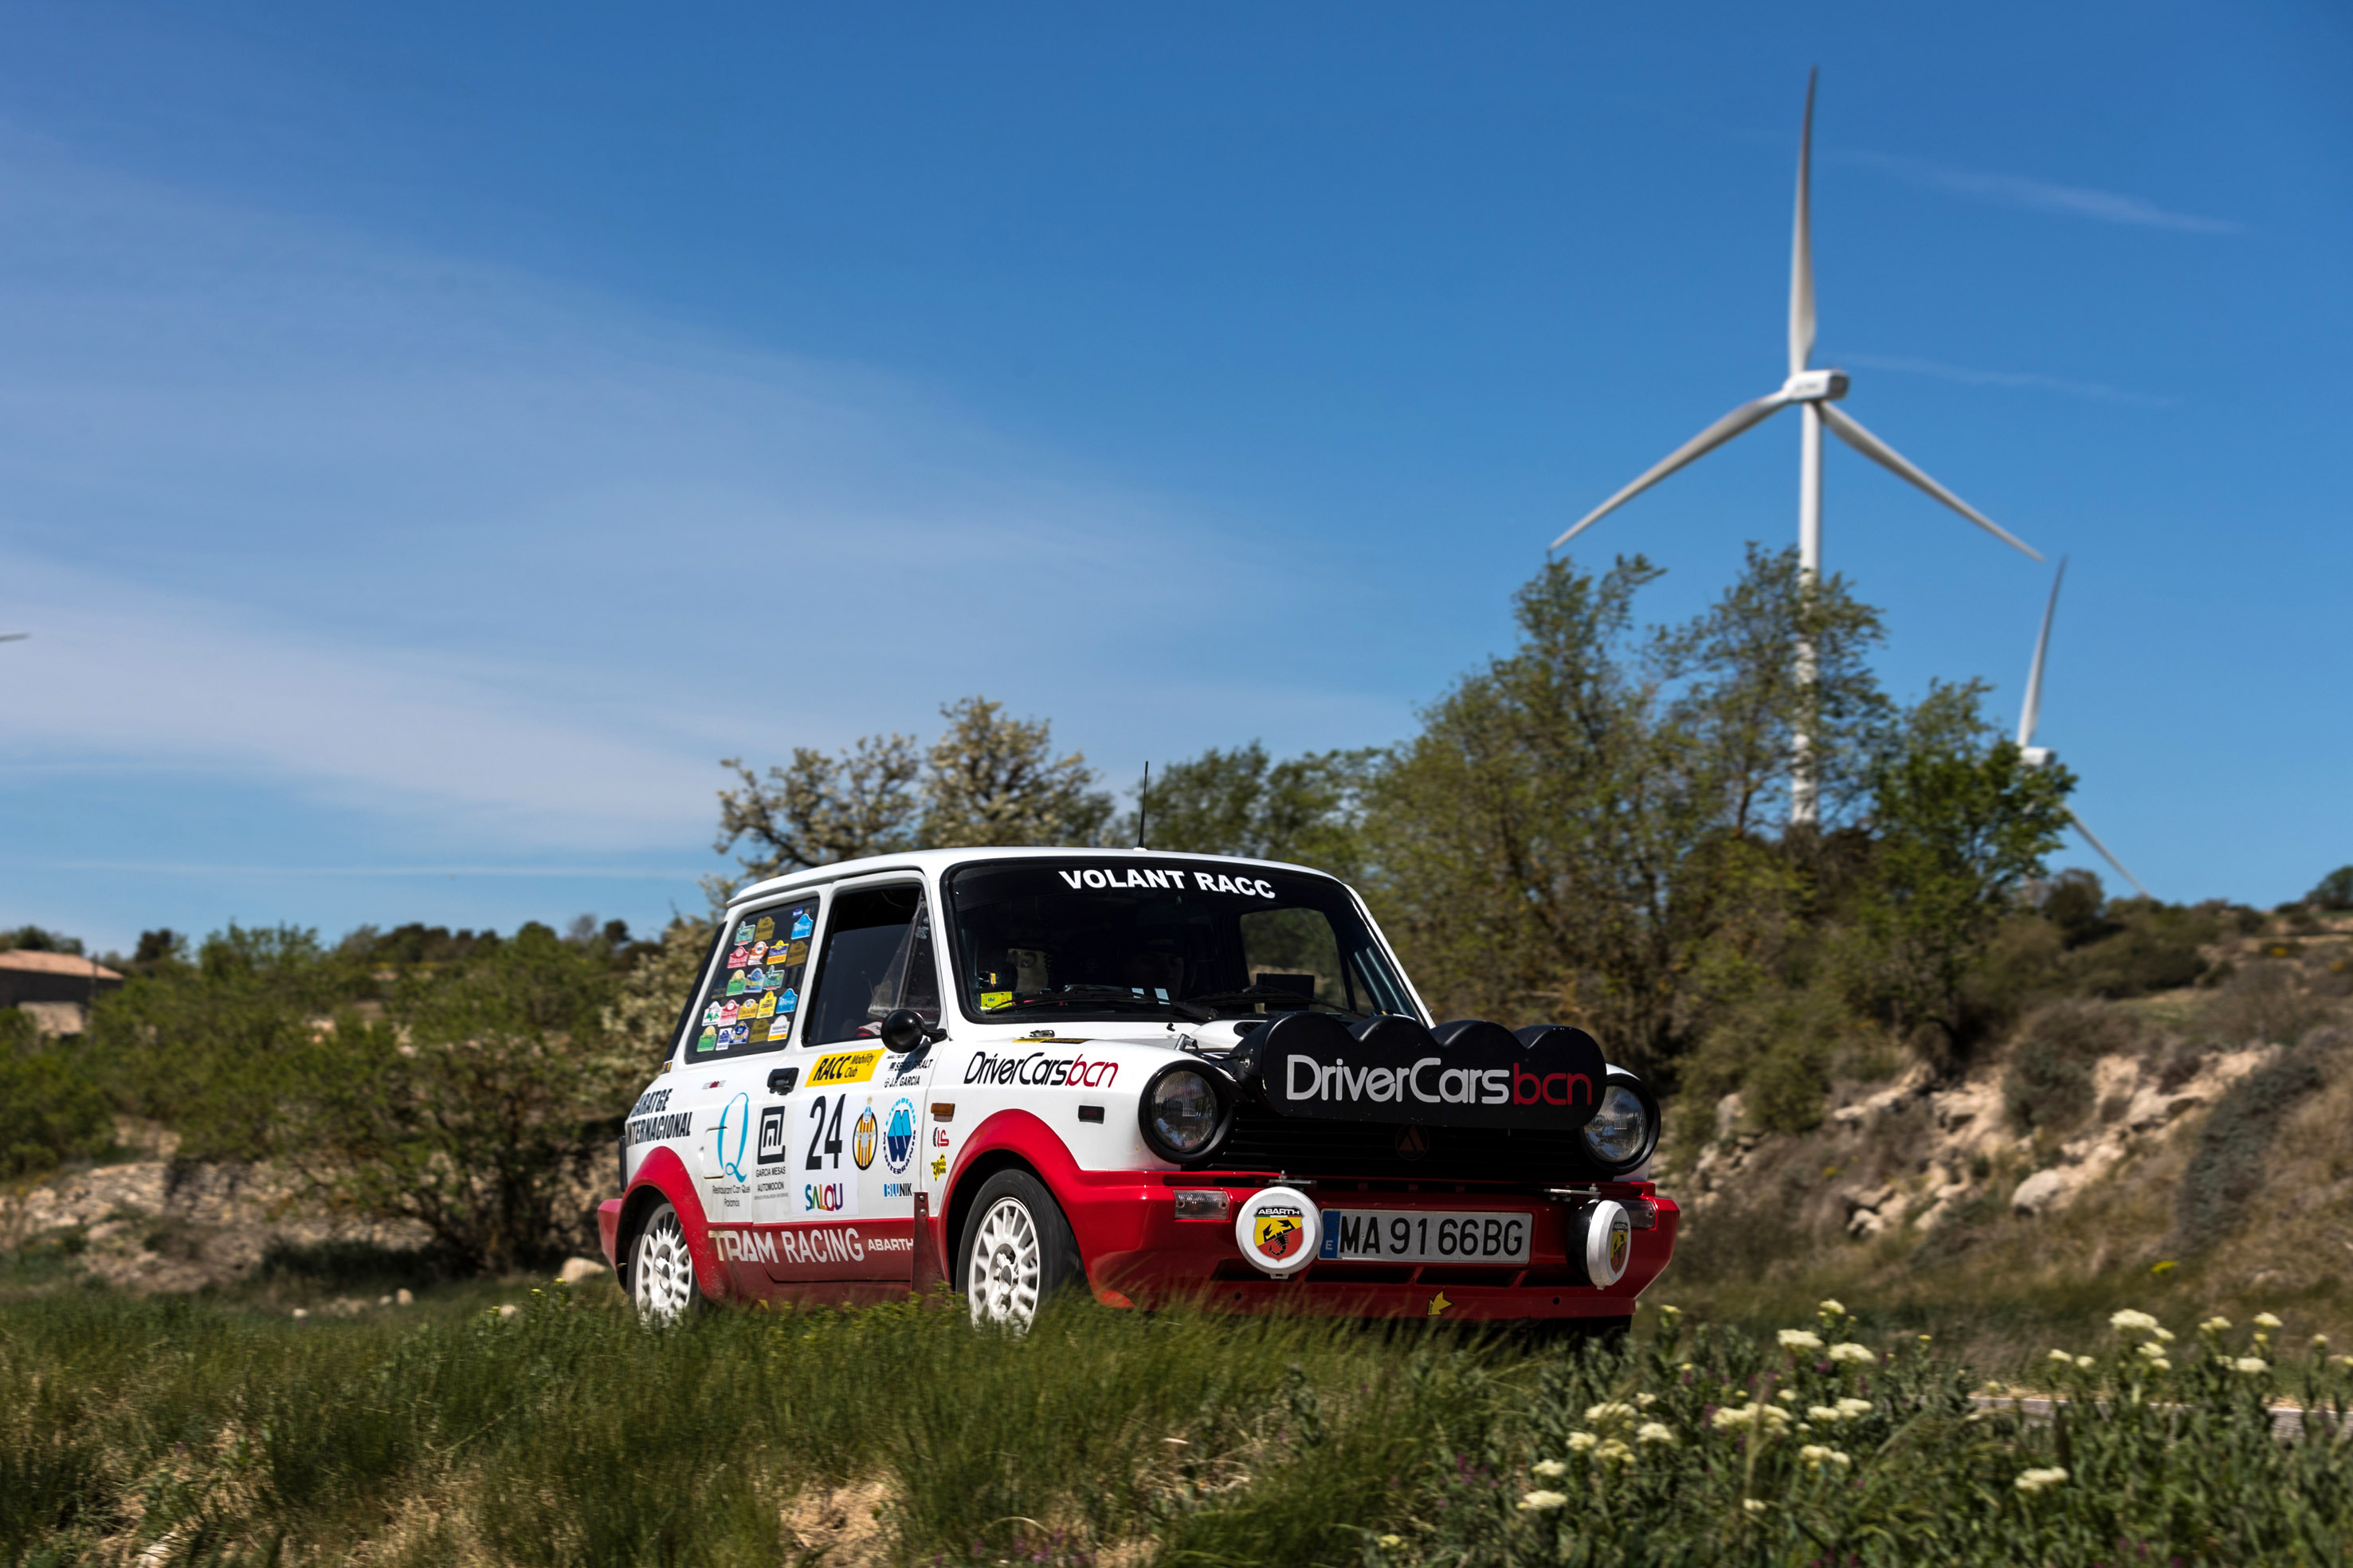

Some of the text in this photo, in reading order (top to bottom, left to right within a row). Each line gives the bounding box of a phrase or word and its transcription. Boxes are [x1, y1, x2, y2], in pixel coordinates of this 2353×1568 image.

[1058, 868, 1276, 900] VOLANT RACC
[813, 1053, 876, 1081] RACC Mobility
[845, 1066, 858, 1078] Club
[900, 1076, 920, 1087] GARCIA
[806, 1093, 846, 1170] 24
[805, 1182, 843, 1211] SALOU
[780, 1227, 865, 1264] RACING
[868, 1238, 913, 1251] ABARTH
[1325, 1239, 1333, 1251] E
